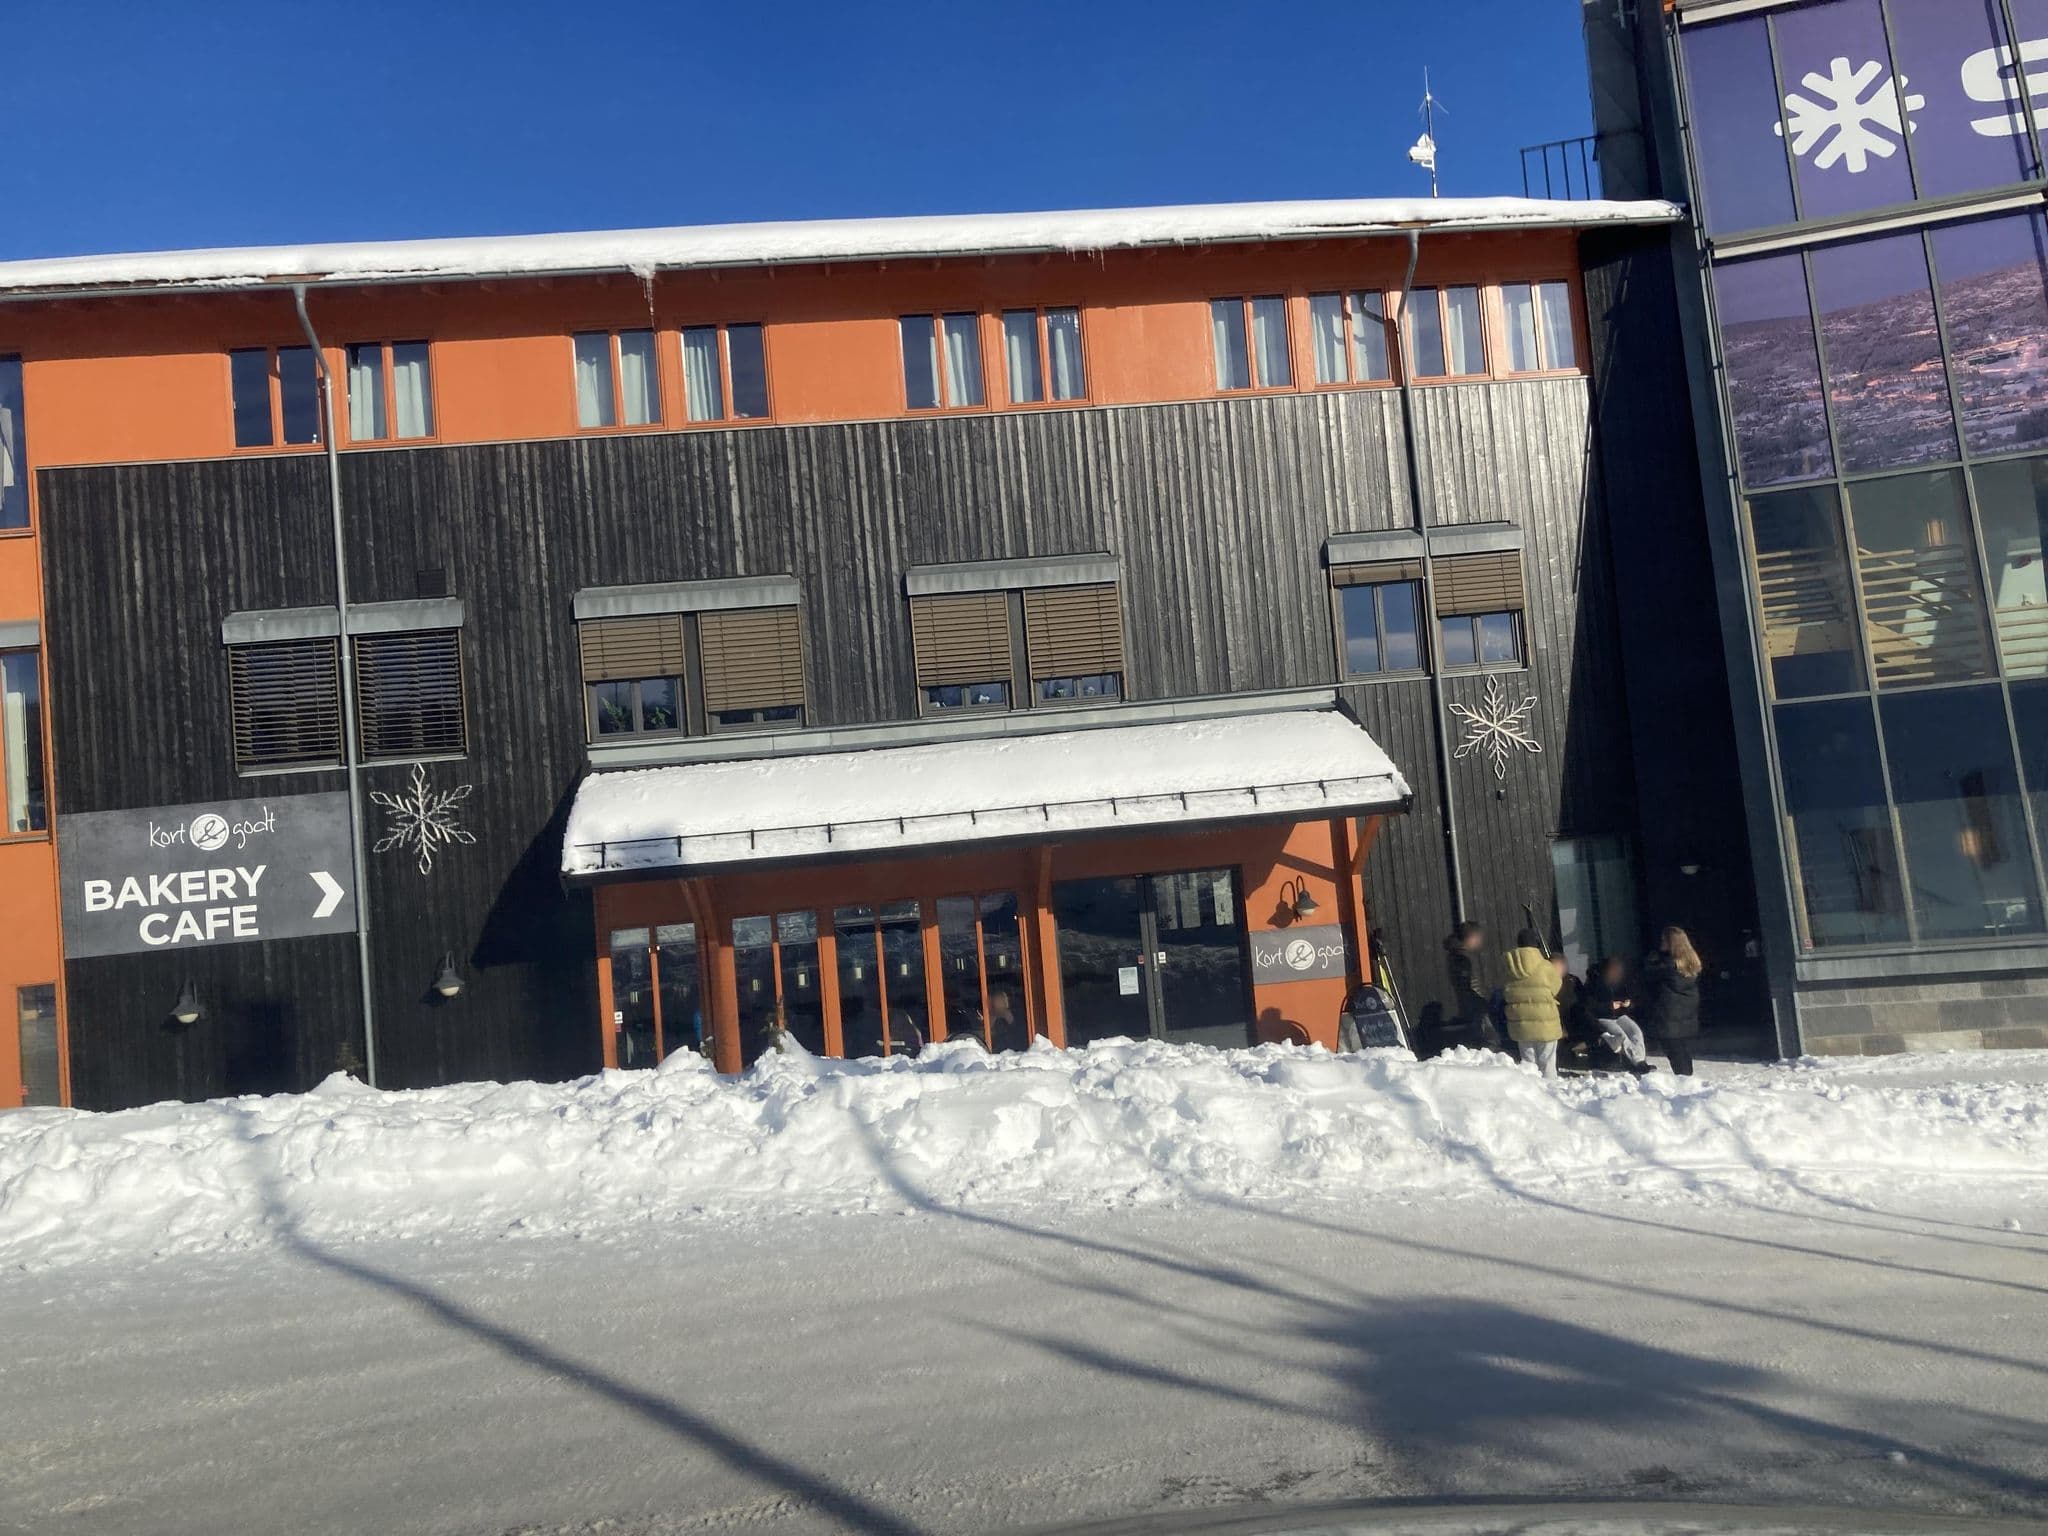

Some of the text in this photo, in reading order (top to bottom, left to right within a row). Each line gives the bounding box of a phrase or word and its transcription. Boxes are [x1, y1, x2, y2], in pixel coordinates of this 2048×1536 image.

[195, 817, 228, 846] &
[233, 806, 276, 849] godt
[84, 865, 267, 912] BAKERY
[139, 905, 259, 945] CAFE
[1289, 942, 1314, 966] &
